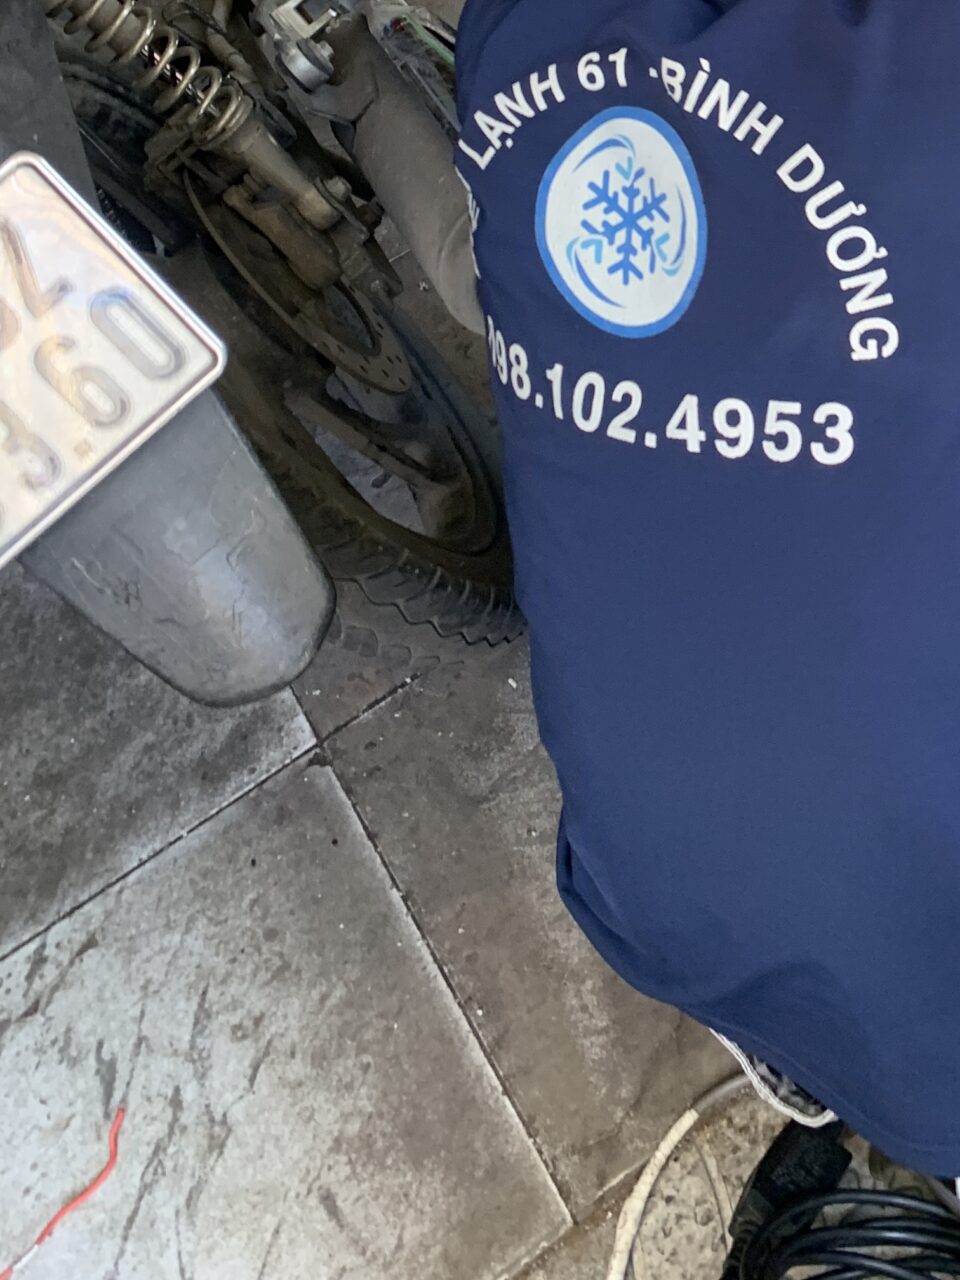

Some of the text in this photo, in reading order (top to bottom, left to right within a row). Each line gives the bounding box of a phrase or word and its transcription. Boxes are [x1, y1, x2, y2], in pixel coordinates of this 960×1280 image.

[458, 63, 566, 170] LẠNH
[577, 47, 629, 92] 61
[775, 142, 900, 362] DƯƠNG
